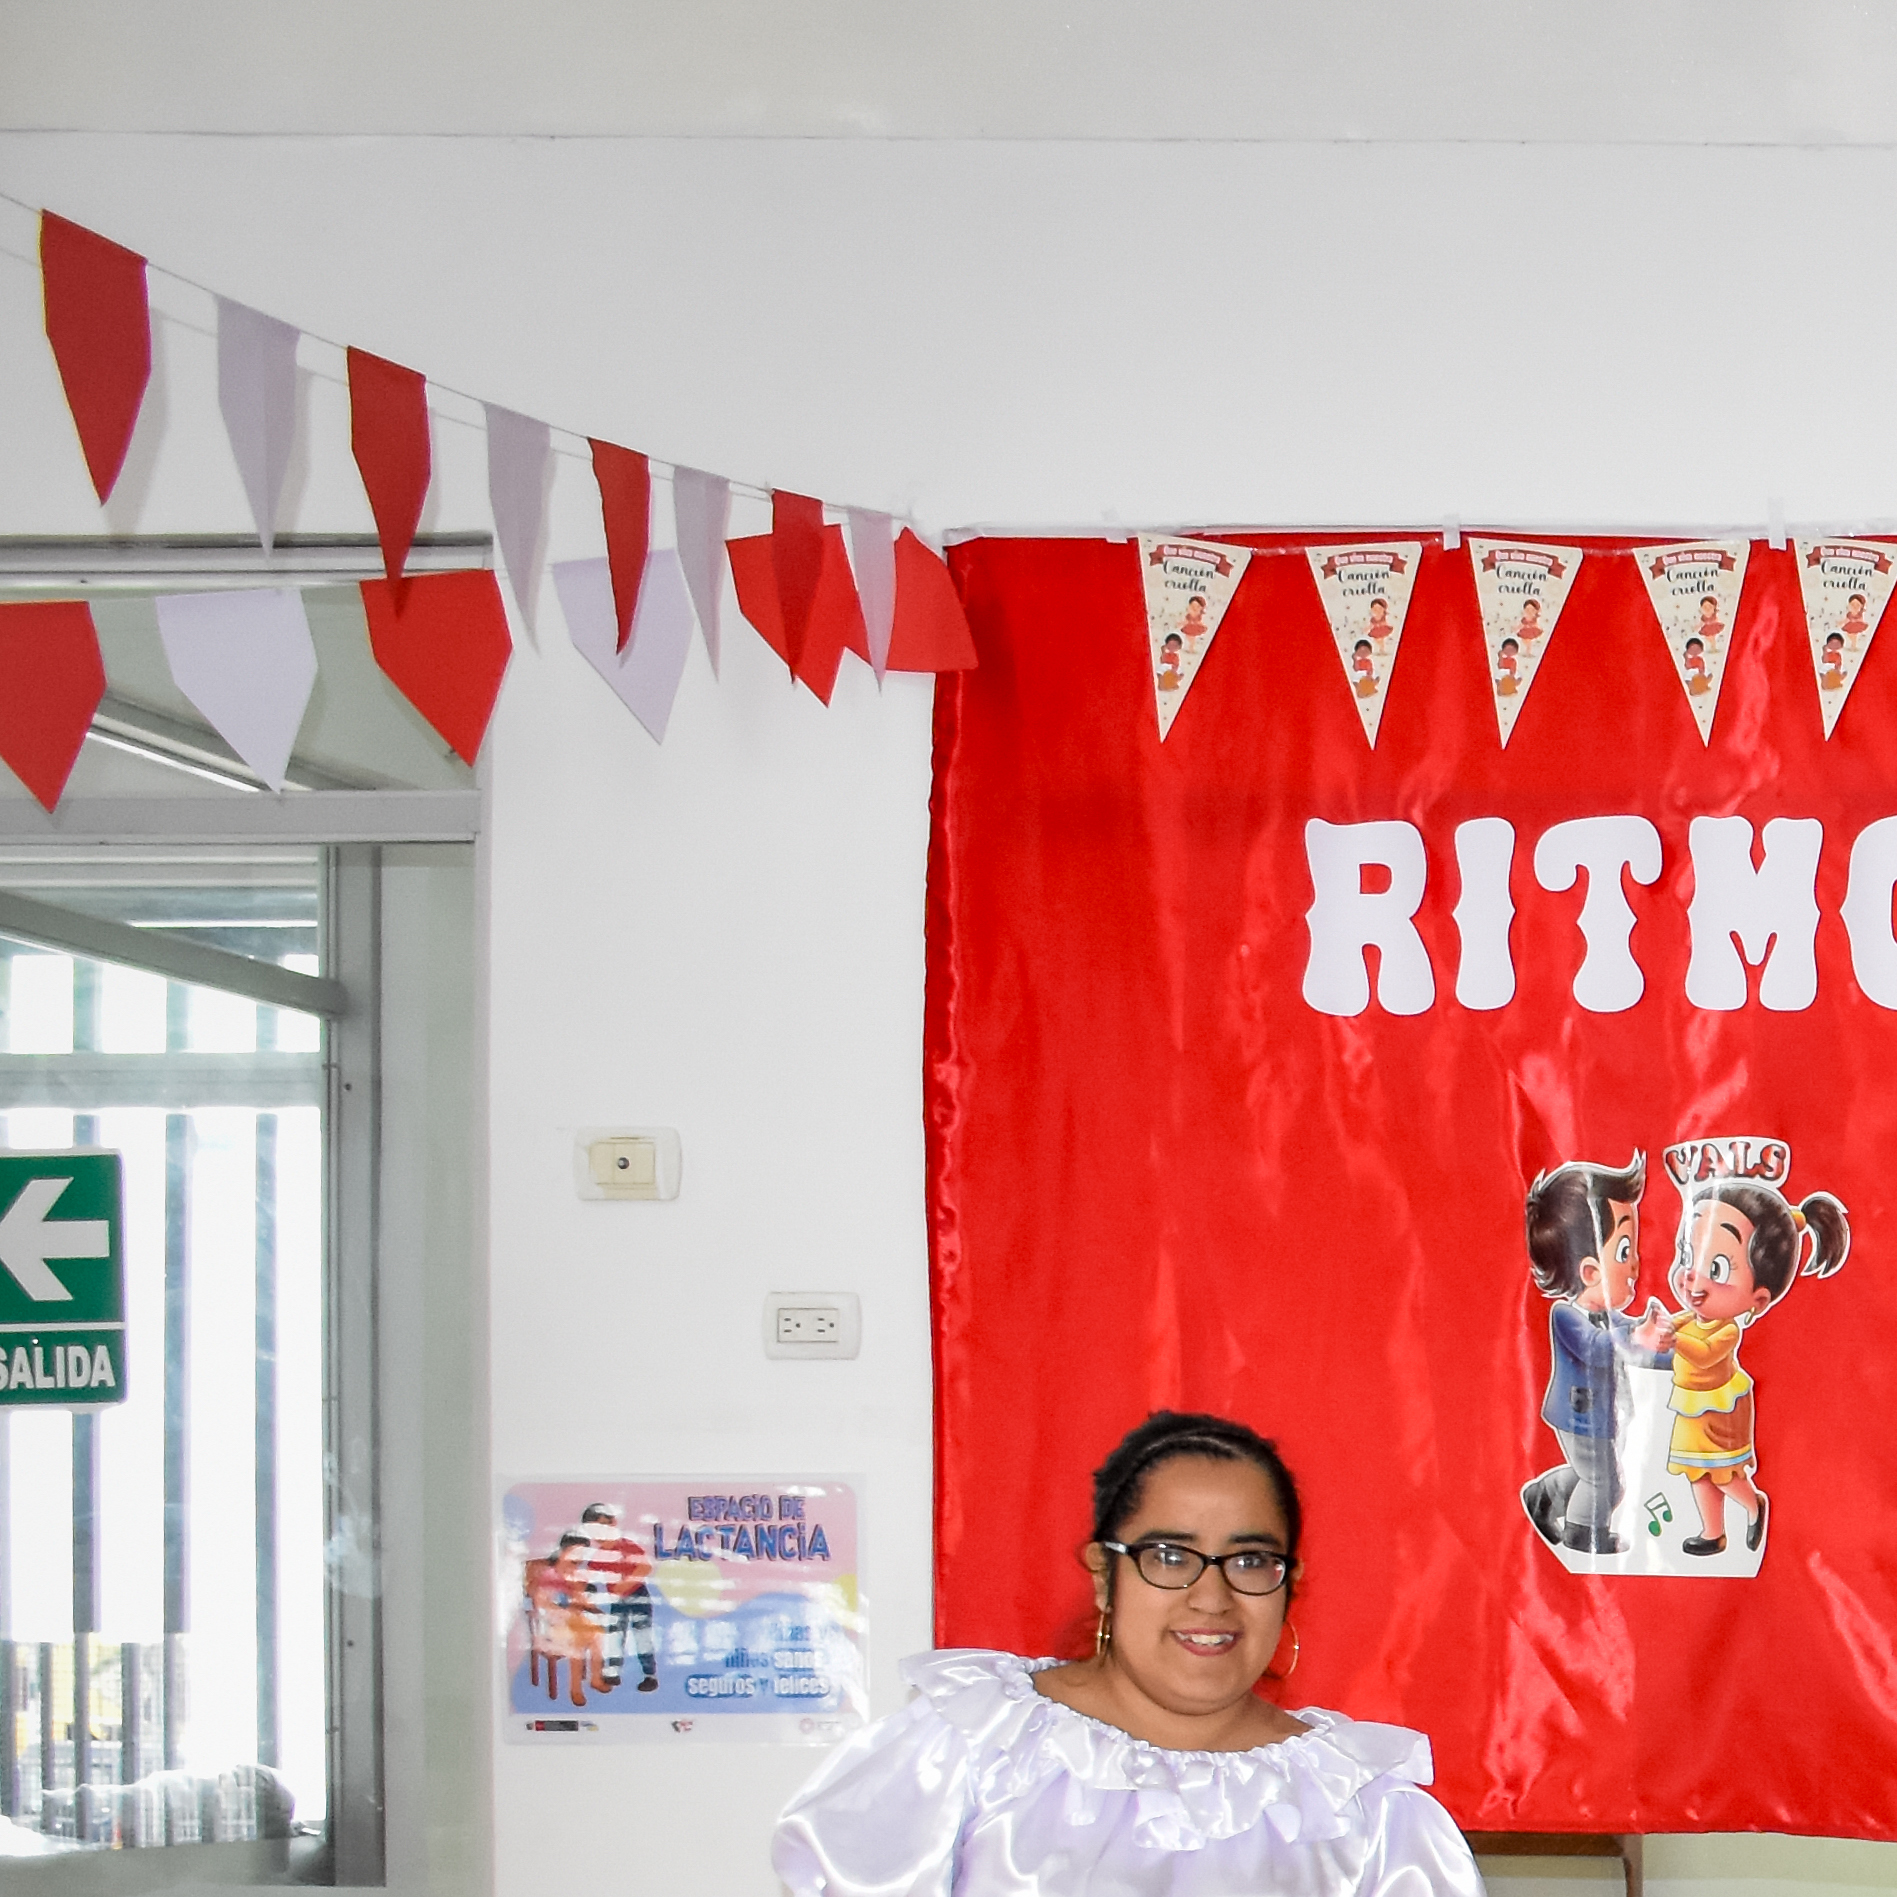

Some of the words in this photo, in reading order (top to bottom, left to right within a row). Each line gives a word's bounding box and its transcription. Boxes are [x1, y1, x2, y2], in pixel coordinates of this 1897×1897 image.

[1665, 1141, 1787, 1185] VALS
[779, 1495, 806, 1520] DE
[688, 1677, 755, 1697] seguros
